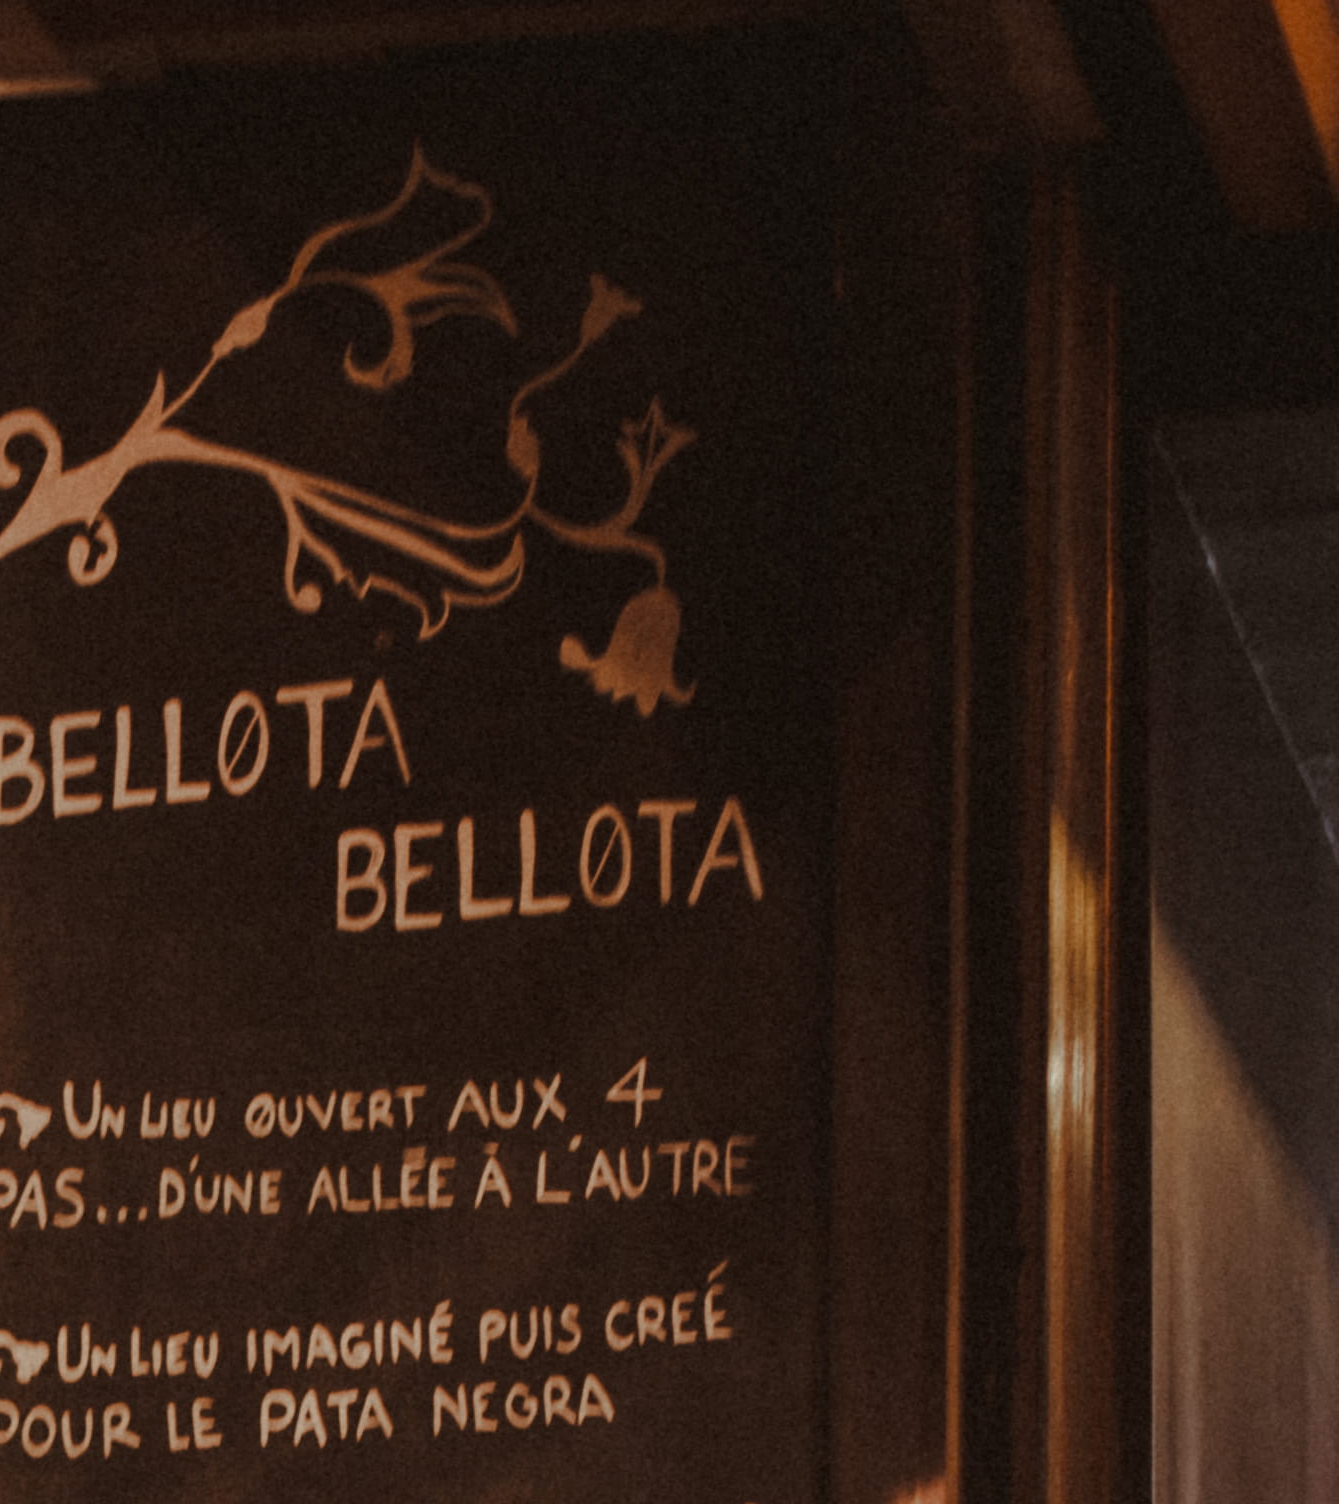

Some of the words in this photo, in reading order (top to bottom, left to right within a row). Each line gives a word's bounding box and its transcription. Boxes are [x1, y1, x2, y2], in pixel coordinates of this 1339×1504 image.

[139, 1092, 217, 1140] LIEU
[446, 1073, 567, 1132] AUX
[605, 1057, 663, 1127] 4
[129, 1326, 220, 1379] LIEU
[245, 1299, 454, 1376] IMAGINÉ
[477, 1303, 583, 1363] PUIS
[165, 1396, 223, 1453] LE
[258, 1387, 394, 1448] PATA
[431, 1373, 616, 1436] NEGRA
